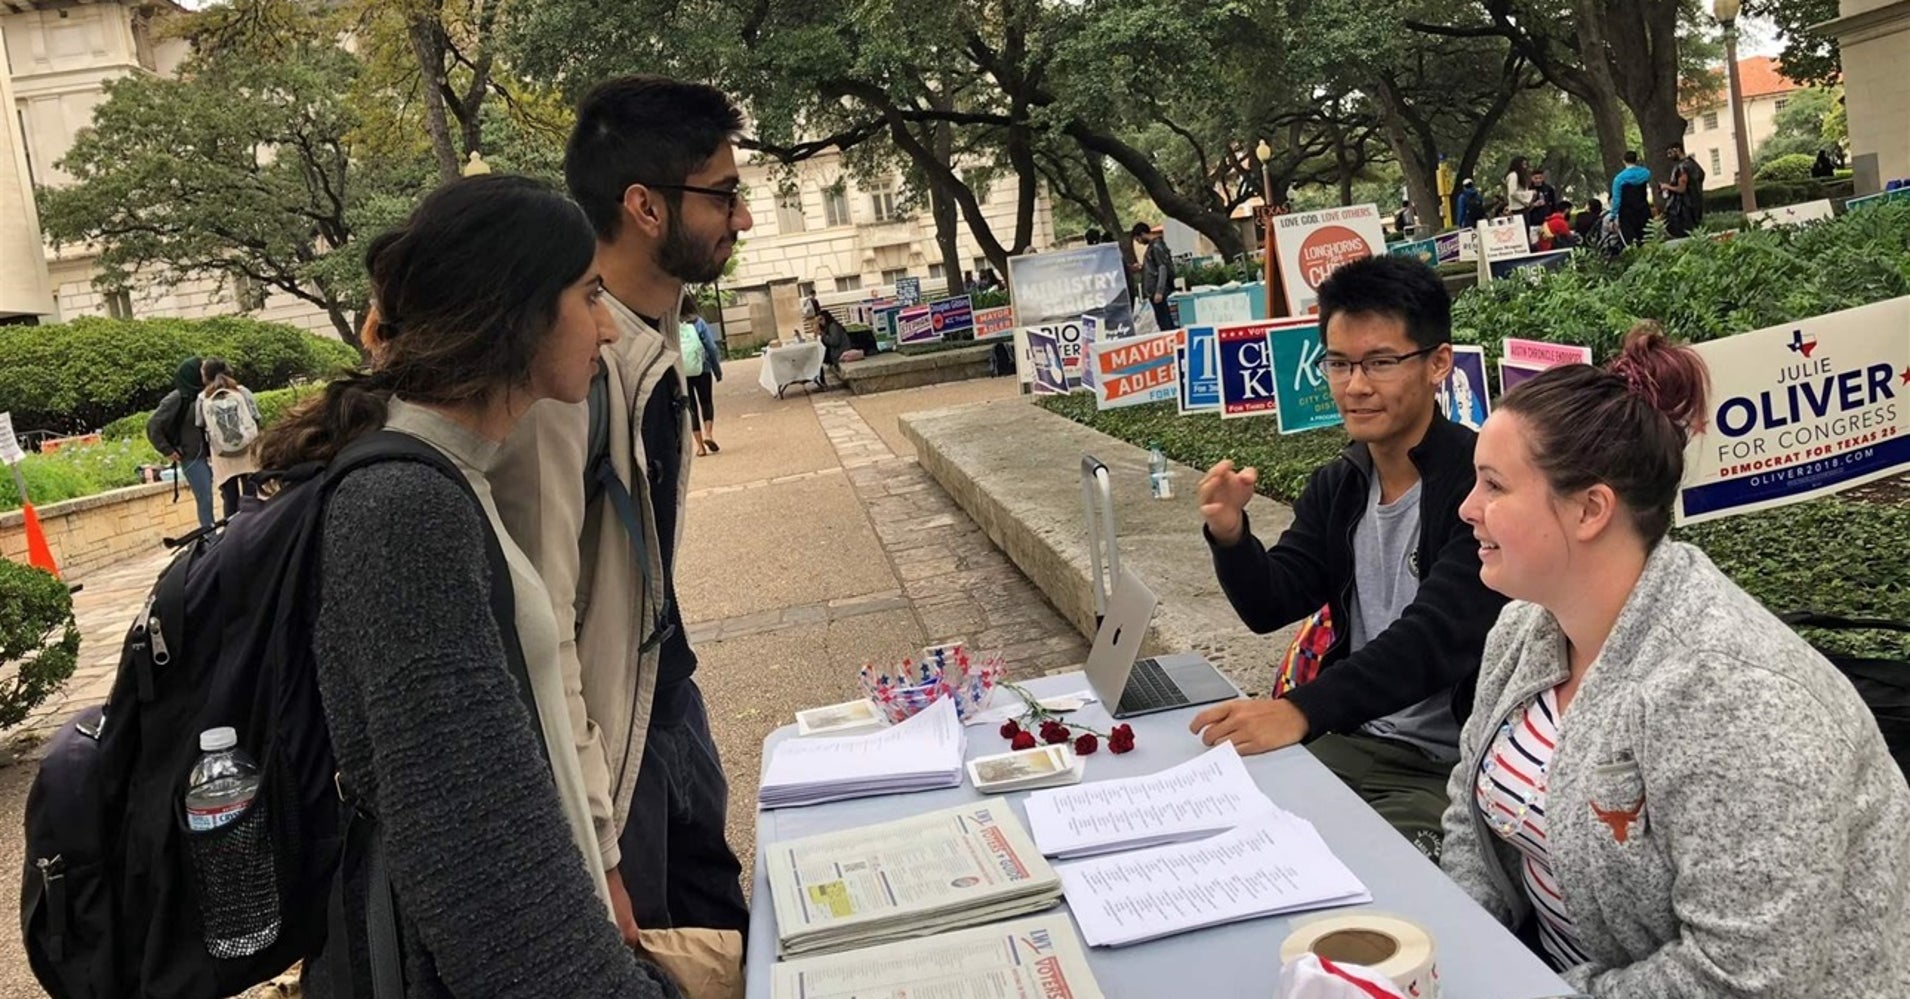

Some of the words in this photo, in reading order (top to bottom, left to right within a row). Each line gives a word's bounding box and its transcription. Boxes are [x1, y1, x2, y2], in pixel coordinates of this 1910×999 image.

[1255, 204, 1289, 216] TEXAS
[1281, 217, 1299, 228] LOVE
[1321, 212, 1340, 222] LOVE
[1304, 238, 1363, 260] LONGHORNS
[1022, 269, 1119, 299] MINISTRY
[980, 308, 1010, 320] MAYOR
[1040, 292, 1107, 316] SERIES
[983, 321, 1012, 334] ADLER
[1110, 334, 1177, 369] MAYOR
[1239, 367, 1275, 400] K
[1777, 357, 1832, 384] JULIE
[1716, 363, 1895, 438] OLIVER
[1718, 437, 1766, 463] FOR
[1778, 404, 1897, 449] CONGRESS
[1720, 452, 1801, 477] DEMOCRAT
[1806, 440, 1832, 459] FOR
[1836, 430, 1877, 451] TEXAS
[1881, 425, 1897, 438] 25
[1750, 448, 1875, 487] OLIVER2018.COM
[1034, 956, 1066, 999] VOTERS
